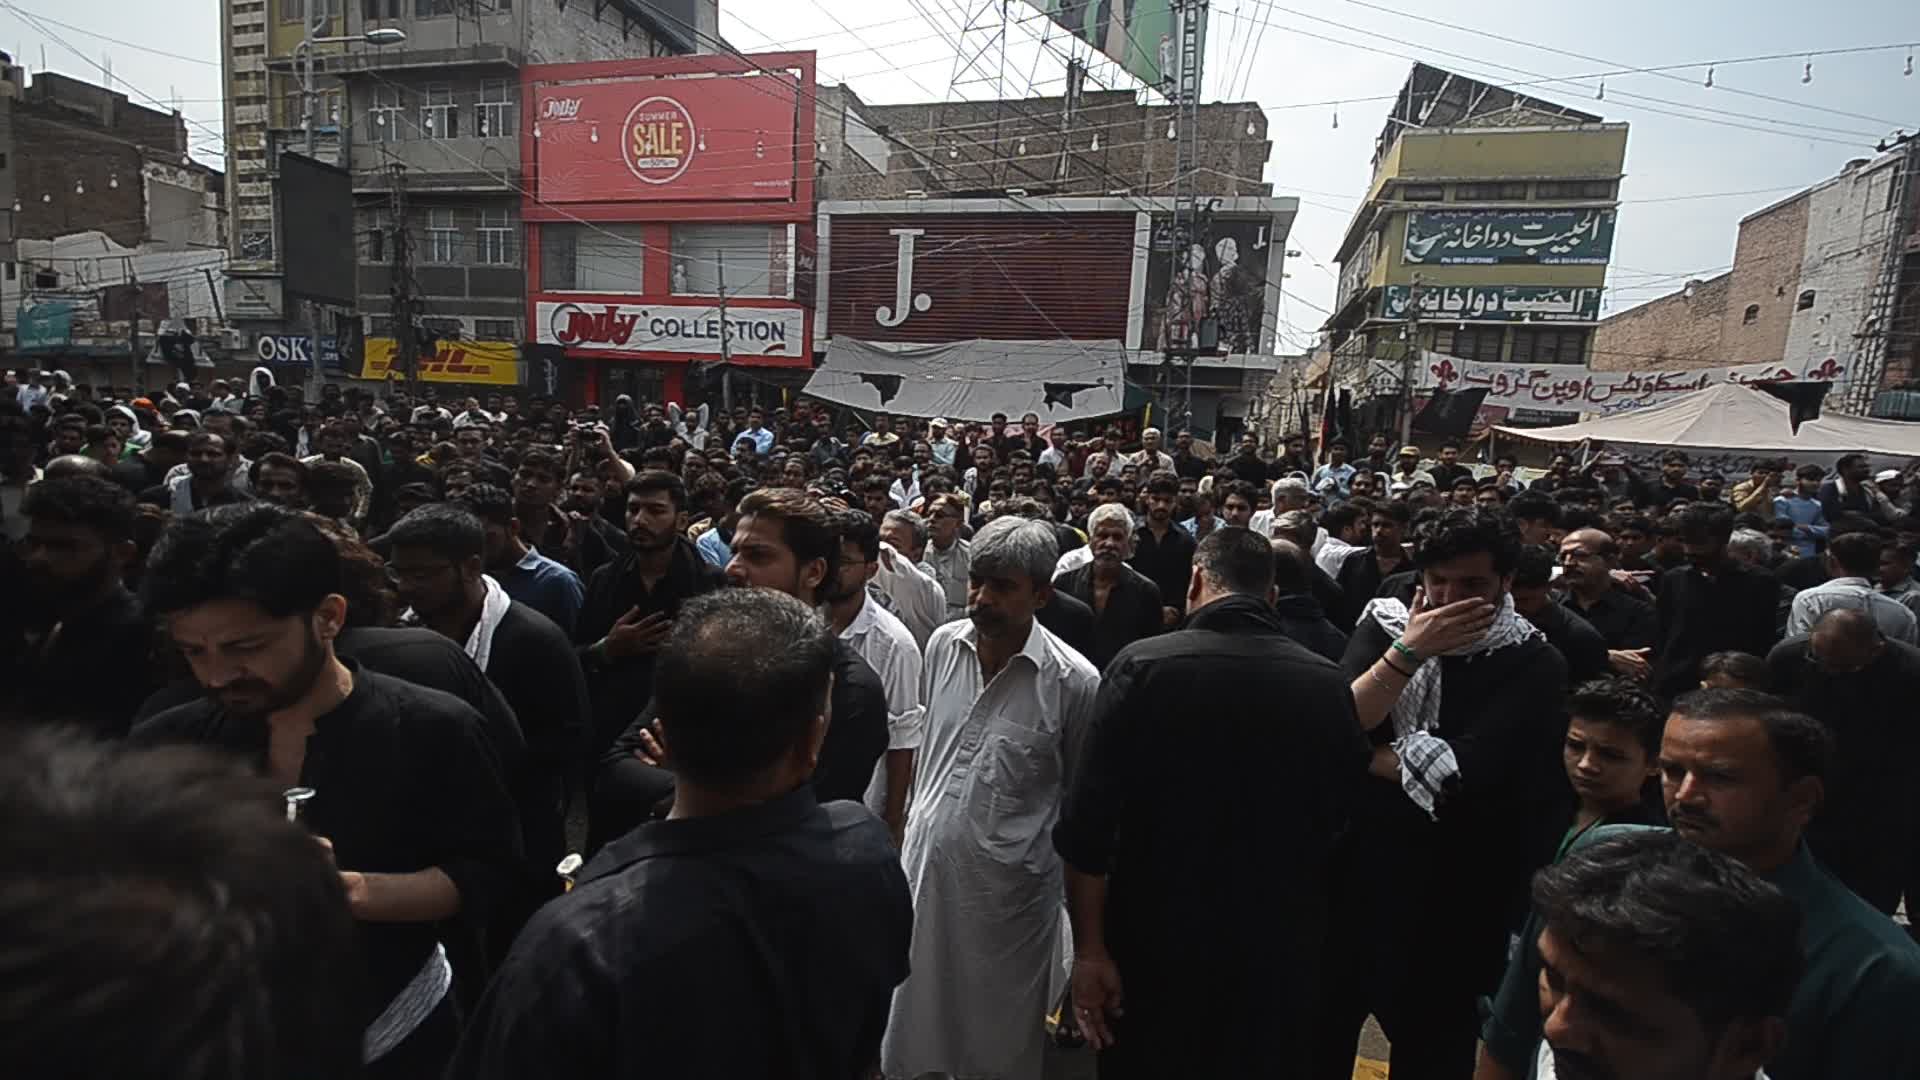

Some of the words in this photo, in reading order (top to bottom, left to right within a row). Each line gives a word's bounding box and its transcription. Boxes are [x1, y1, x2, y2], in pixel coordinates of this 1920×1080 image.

[639, 111, 678, 122] SUMMER
[632, 122, 684, 156] SALE
[875, 228, 932, 327] J.
[553, 304, 640, 346] Jolly
[649, 317, 785, 341] COLLECTION
[258, 336, 308, 362] OSK
